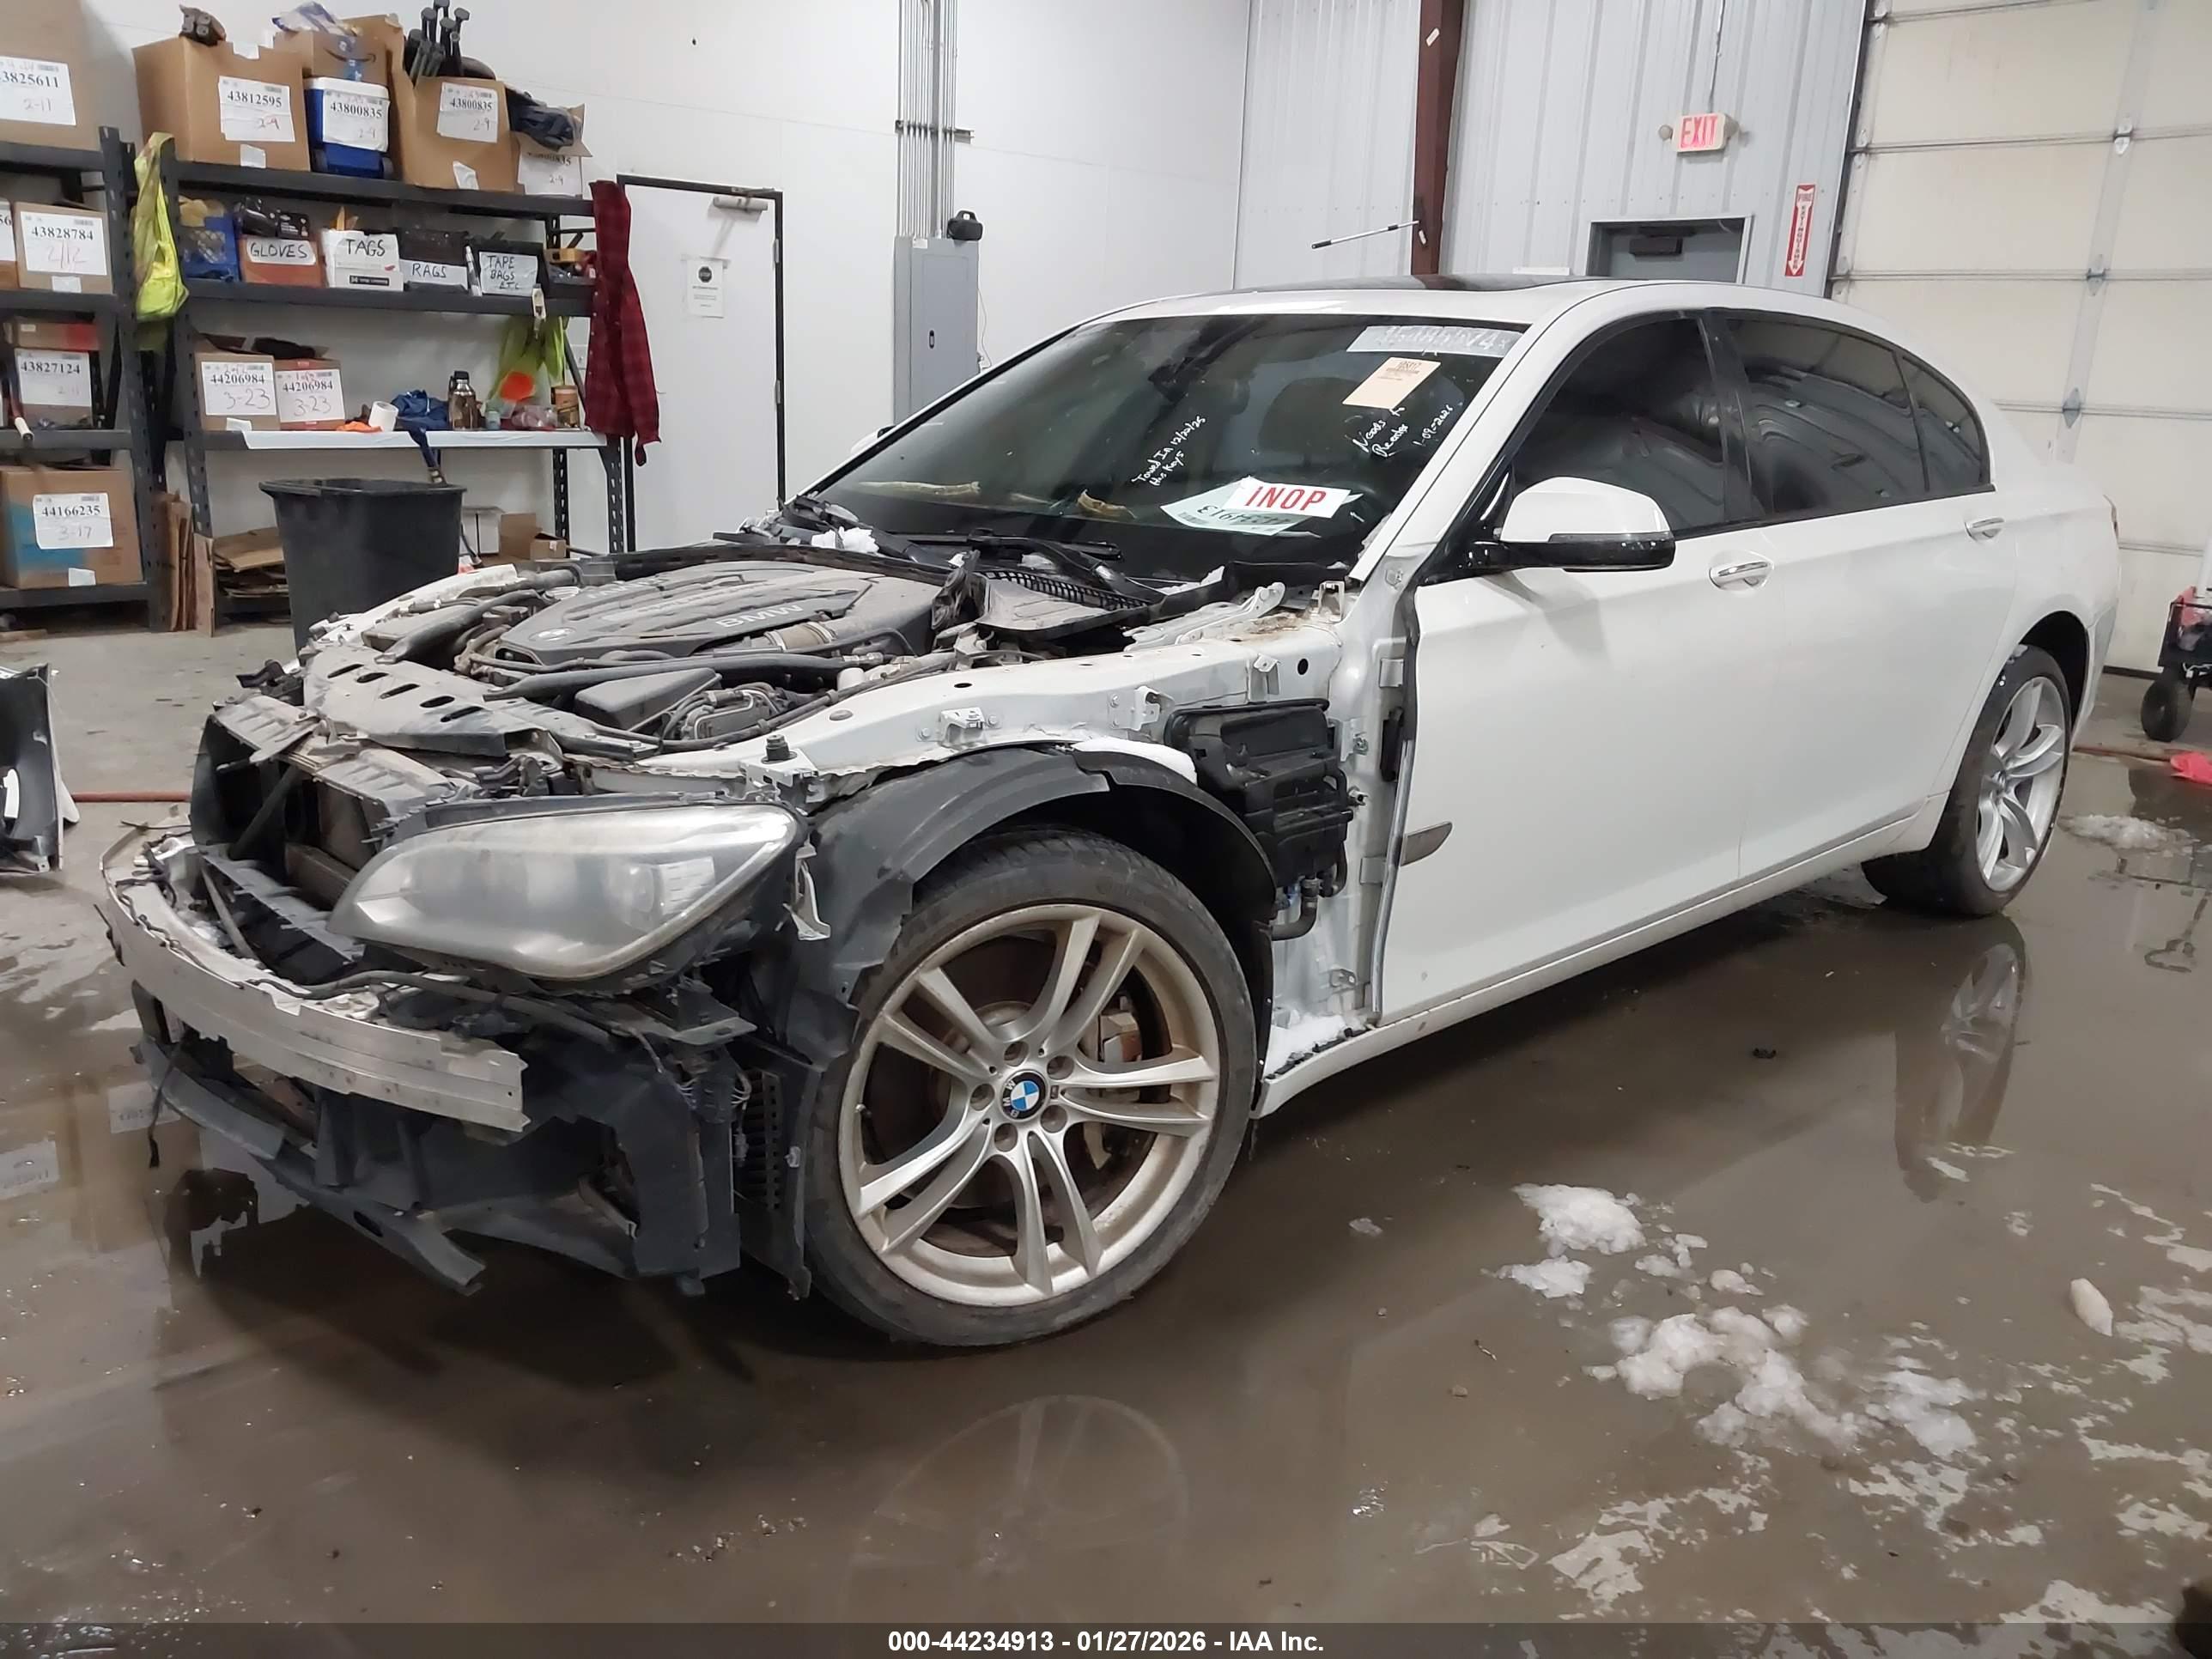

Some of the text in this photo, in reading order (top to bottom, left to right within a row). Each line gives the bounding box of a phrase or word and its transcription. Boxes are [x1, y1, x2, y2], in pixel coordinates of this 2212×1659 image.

[0, 70, 58, 88] 3825611
[227, 90, 283, 108] 43812595
[449, 97, 493, 112] 43800835
[330, 100, 383, 118] 43800835
[1680, 115, 1718, 149] EXIT
[32, 226, 94, 240] 43828784
[250, 241, 308, 258] GLOVES
[345, 239, 386, 257] TAGS
[412, 263, 447, 278] RAGS
[487, 255, 515, 269] TAPE
[490, 270, 515, 282] BAGS
[21, 362, 81, 374] 43827124
[210, 374, 265, 385] 44206984
[283, 380, 333, 392] 44206984
[223, 388, 270, 410] 3-23
[293, 395, 332, 416] 3-23
[1244, 485, 1327, 511] INOP
[41, 505, 100, 516] 44166235
[715, 604, 804, 628] BMW
